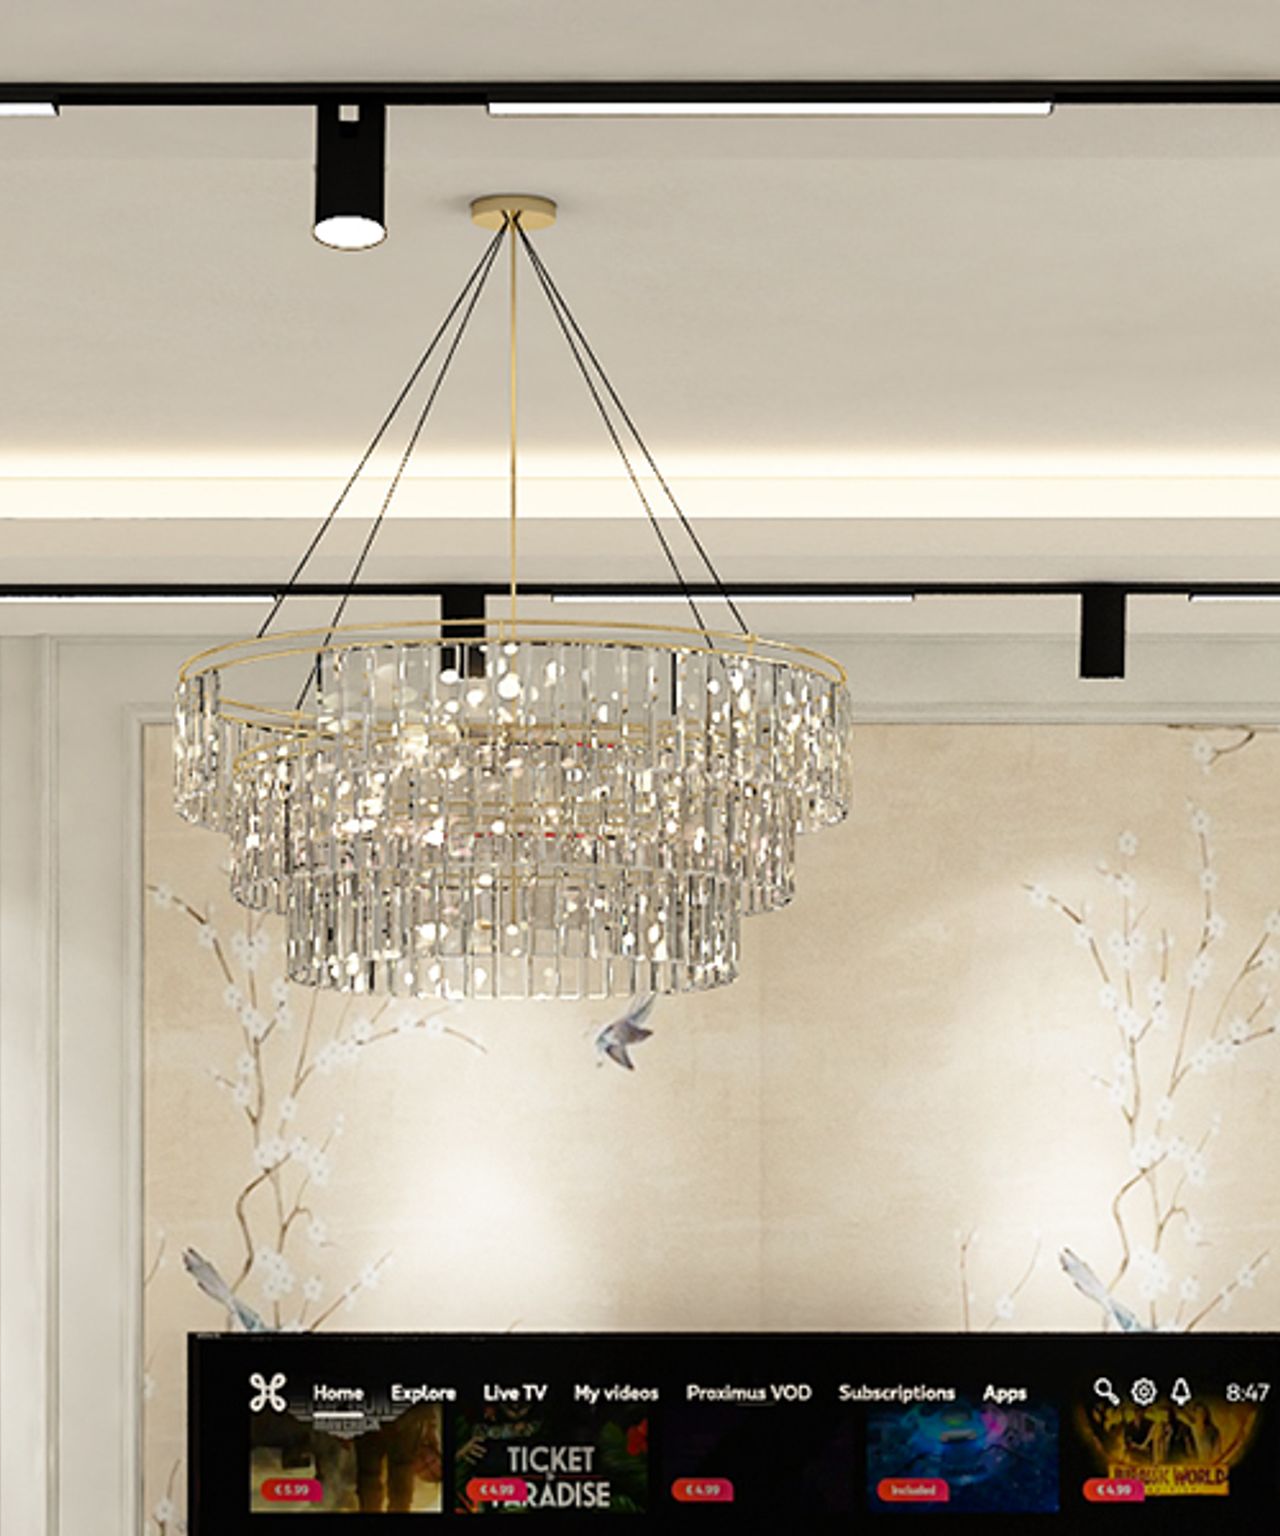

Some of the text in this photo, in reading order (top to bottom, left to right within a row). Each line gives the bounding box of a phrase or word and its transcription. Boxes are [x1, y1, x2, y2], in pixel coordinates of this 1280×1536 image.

[313, 1384, 365, 1401] Home
[391, 1384, 457, 1405] Explore
[483, 1384, 548, 1401] Live TV
[574, 1384, 659, 1405] My videos
[686, 1384, 813, 1401] Proximus VOD
[838, 1384, 956, 1404] Subscriptions
[982, 1384, 1028, 1404] Apps
[1226, 1383, 1271, 1402] 8:47
[506, 1446, 595, 1473] TICKET
[1173, 1466, 1227, 1486] WORLD
[491, 1482, 610, 1507] RADISE
[891, 1485, 936, 1496] Included
